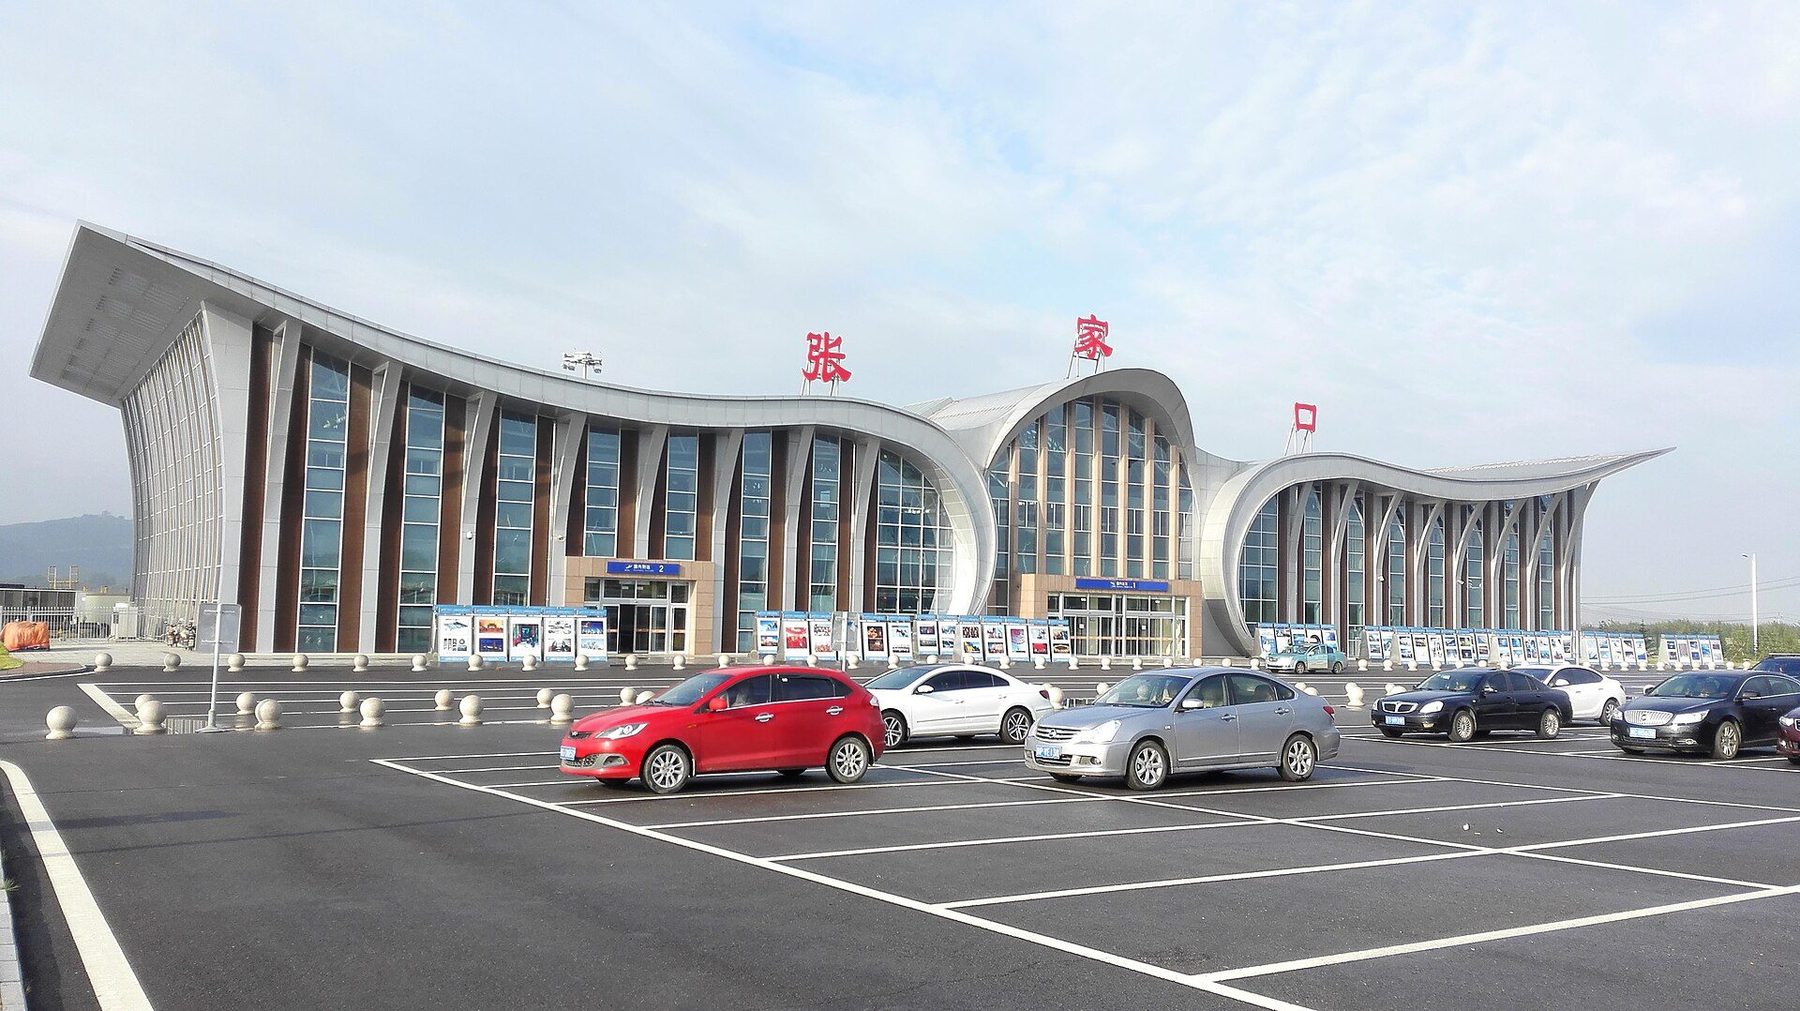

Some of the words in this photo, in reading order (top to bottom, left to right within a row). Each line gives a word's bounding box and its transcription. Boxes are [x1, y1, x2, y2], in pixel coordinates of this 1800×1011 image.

[802, 332, 852, 383] 张
[1074, 314, 1113, 360] 家
[1294, 403, 1317, 432] 口
[659, 565, 664, 573] 2
